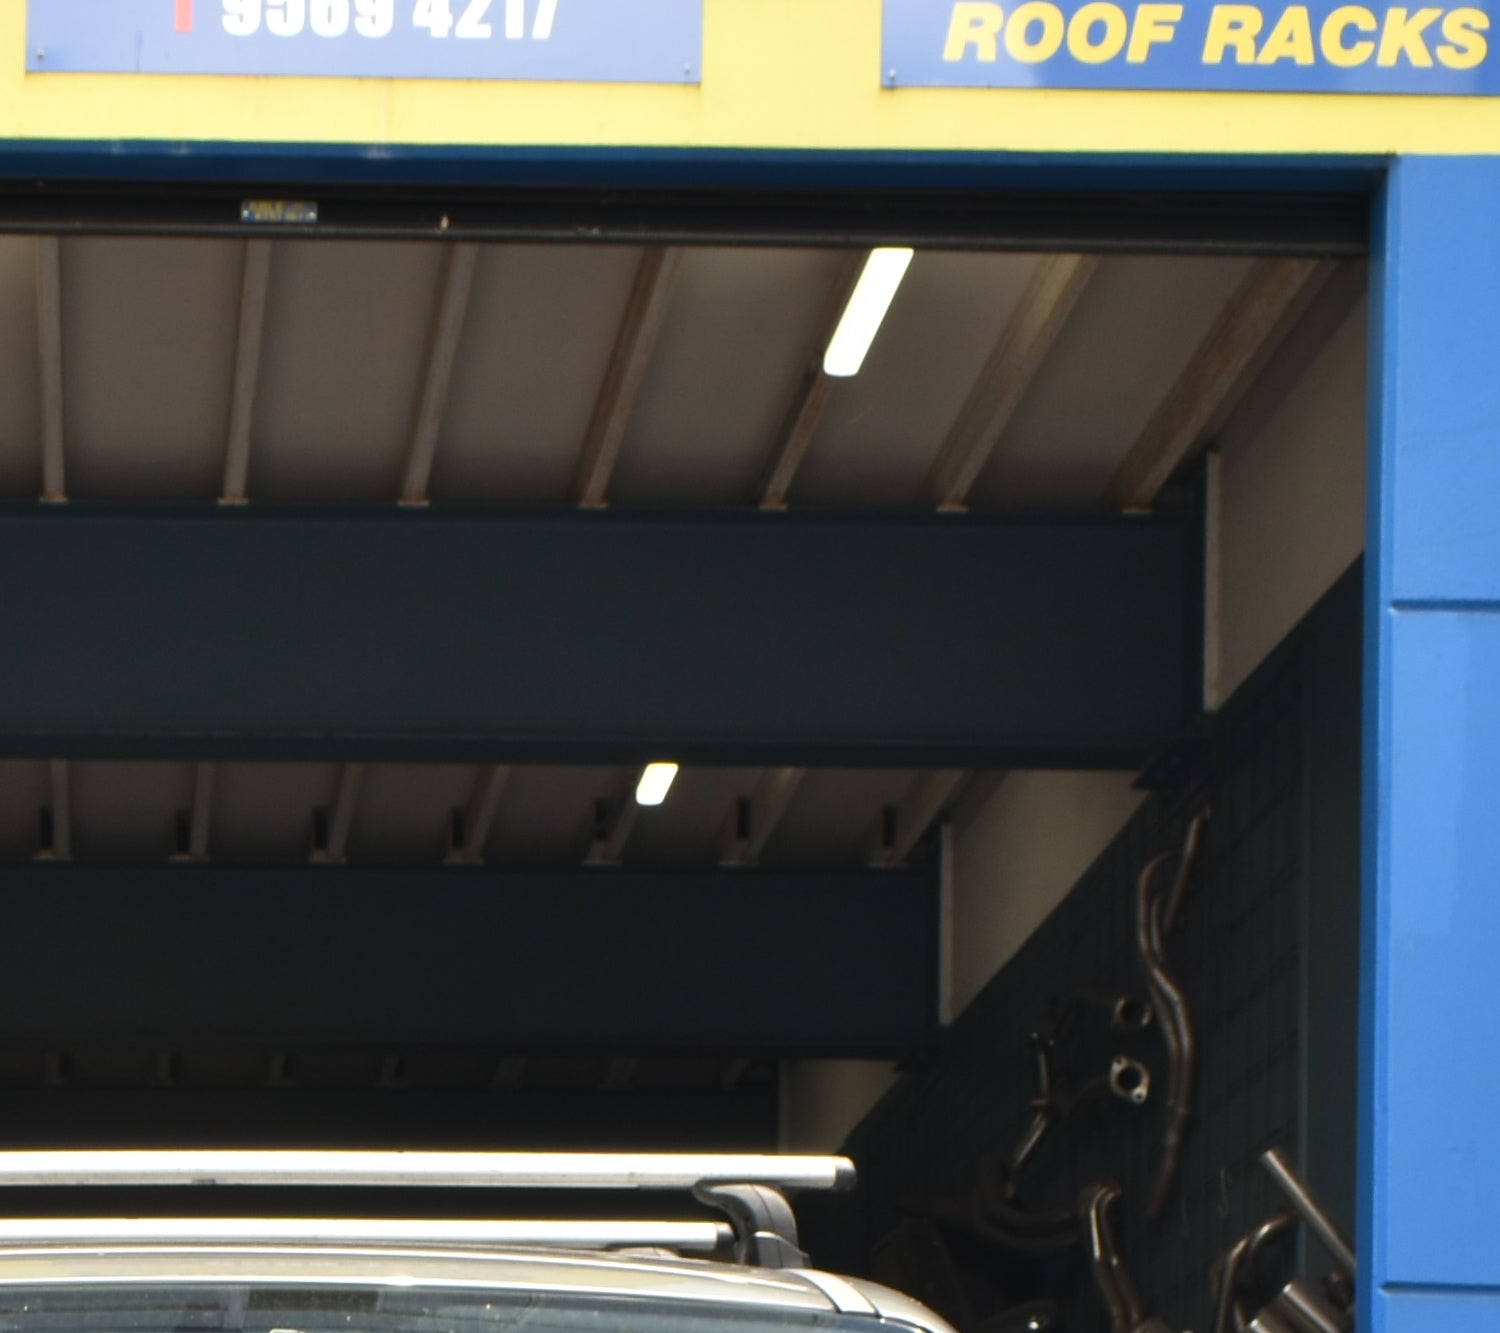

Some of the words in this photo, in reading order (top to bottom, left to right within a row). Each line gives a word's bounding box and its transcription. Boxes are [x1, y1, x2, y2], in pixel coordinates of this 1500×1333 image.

[412, 0, 560, 39] 4217
[942, 1, 1181, 63] ROOF
[1202, 4, 1491, 68] RACKS
